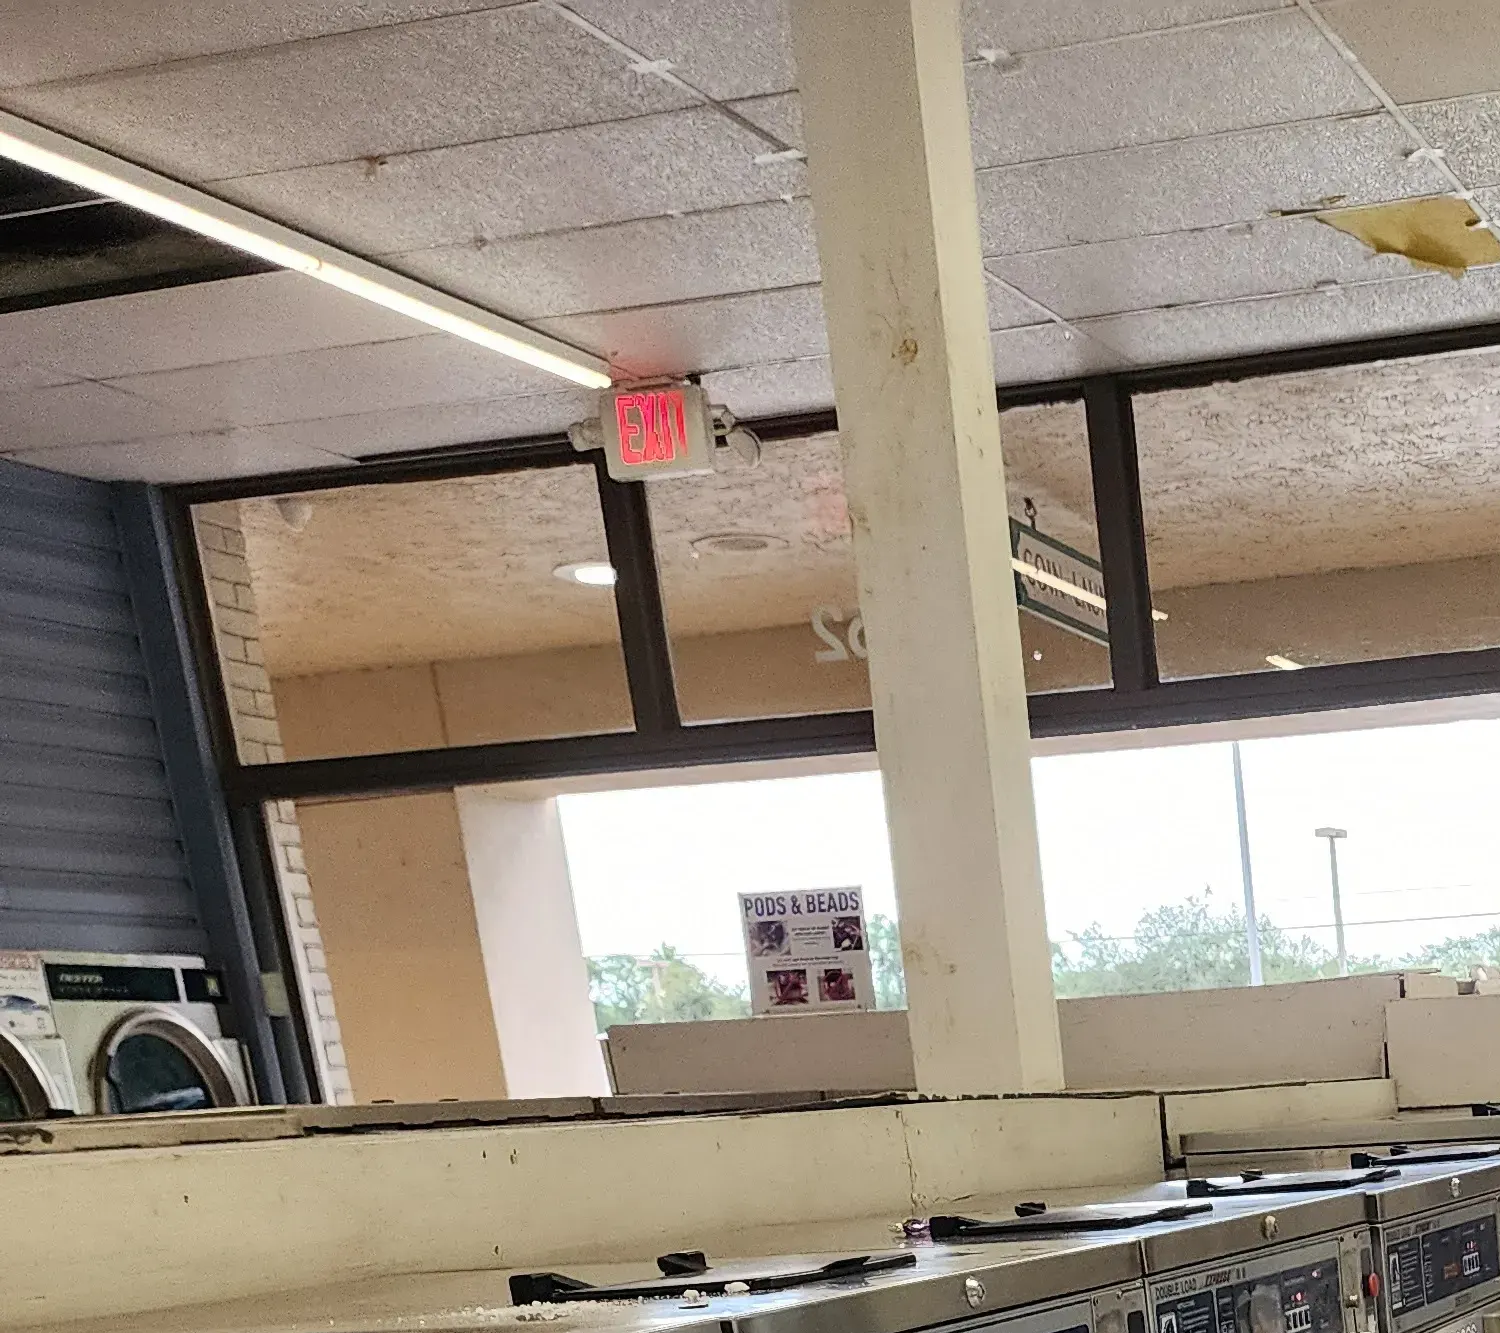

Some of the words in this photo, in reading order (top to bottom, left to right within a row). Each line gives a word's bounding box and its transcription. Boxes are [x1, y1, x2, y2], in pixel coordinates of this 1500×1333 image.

[615, 387, 688, 465] EXIT
[744, 896, 786, 917] PODS
[791, 895, 803, 915] &
[806, 891, 860, 914] BEADS
